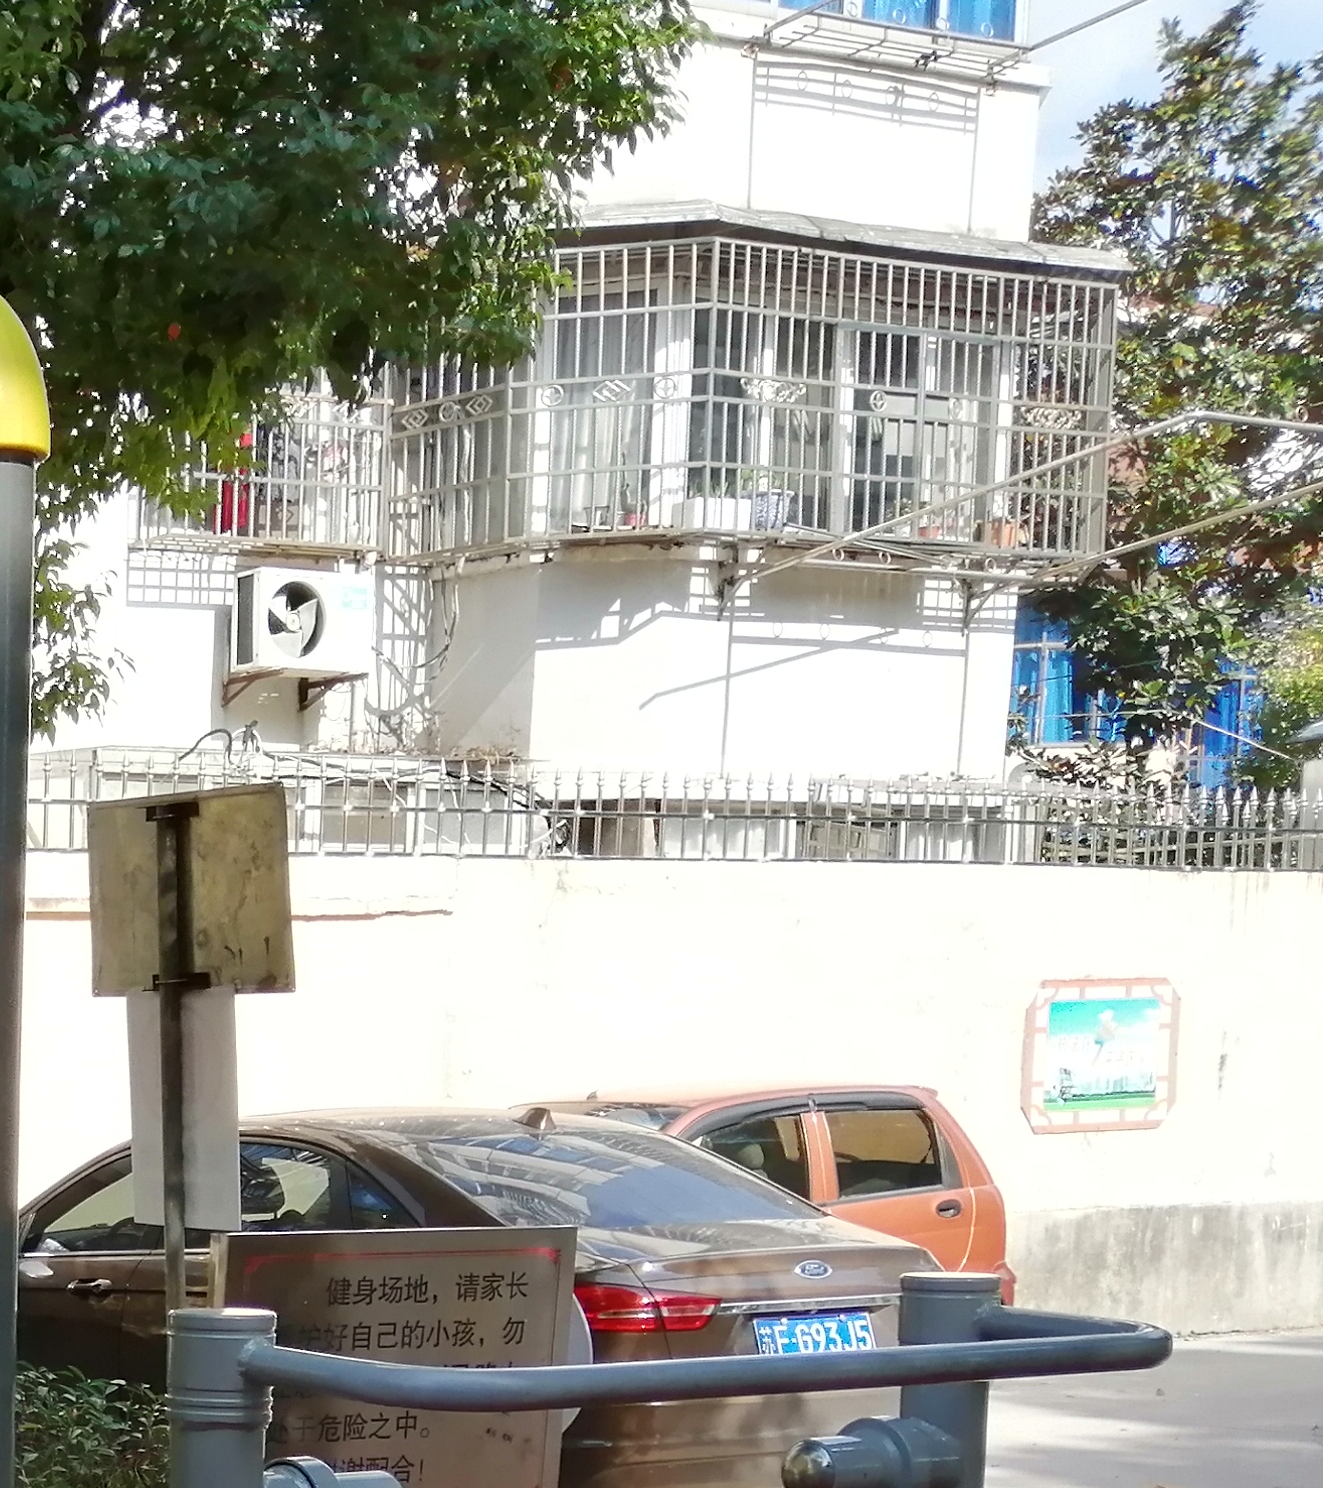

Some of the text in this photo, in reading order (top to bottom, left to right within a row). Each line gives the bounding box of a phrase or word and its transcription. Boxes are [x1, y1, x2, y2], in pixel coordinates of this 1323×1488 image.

[326, 1271, 530, 1306] 健身场地，请家长
[279, 1317, 527, 1354] 护好自己的小孩，勿
